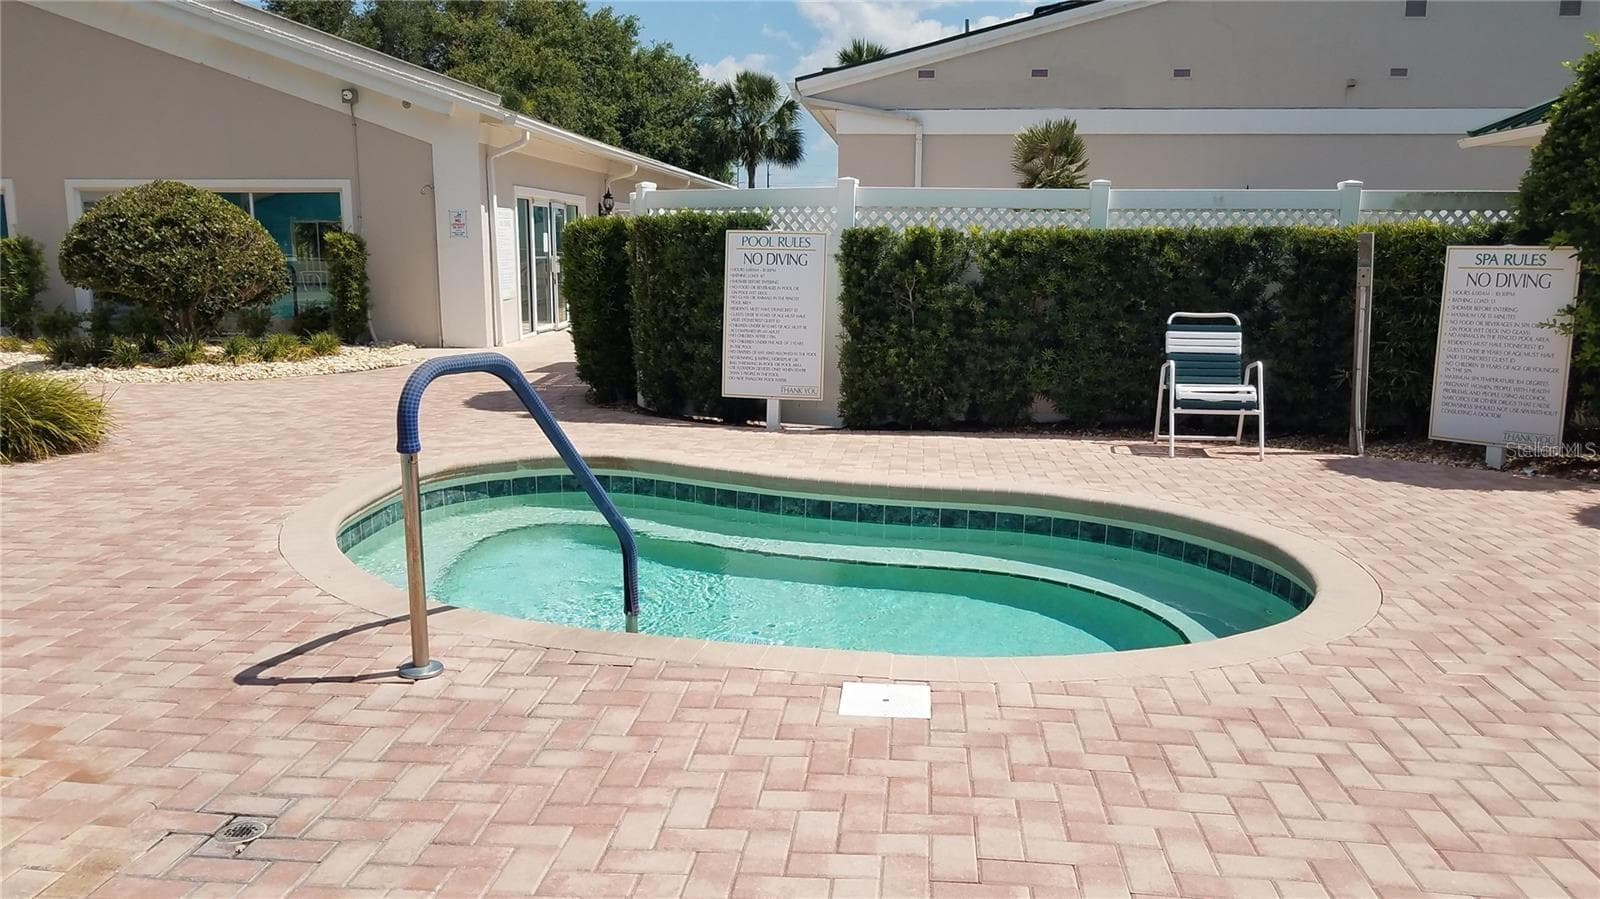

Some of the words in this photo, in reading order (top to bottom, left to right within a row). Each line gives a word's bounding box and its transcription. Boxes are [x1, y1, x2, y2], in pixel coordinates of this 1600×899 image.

[742, 236, 774, 248] POOL
[778, 236, 811, 248] RULES
[744, 252, 763, 266] NO
[766, 252, 808, 266] DIVING
[1475, 254, 1498, 266] SPA
[1504, 254, 1547, 266] RULES
[1466, 272, 1492, 288] NO
[1496, 272, 1552, 289] DIVING
[1504, 432, 1534, 443] THANK
